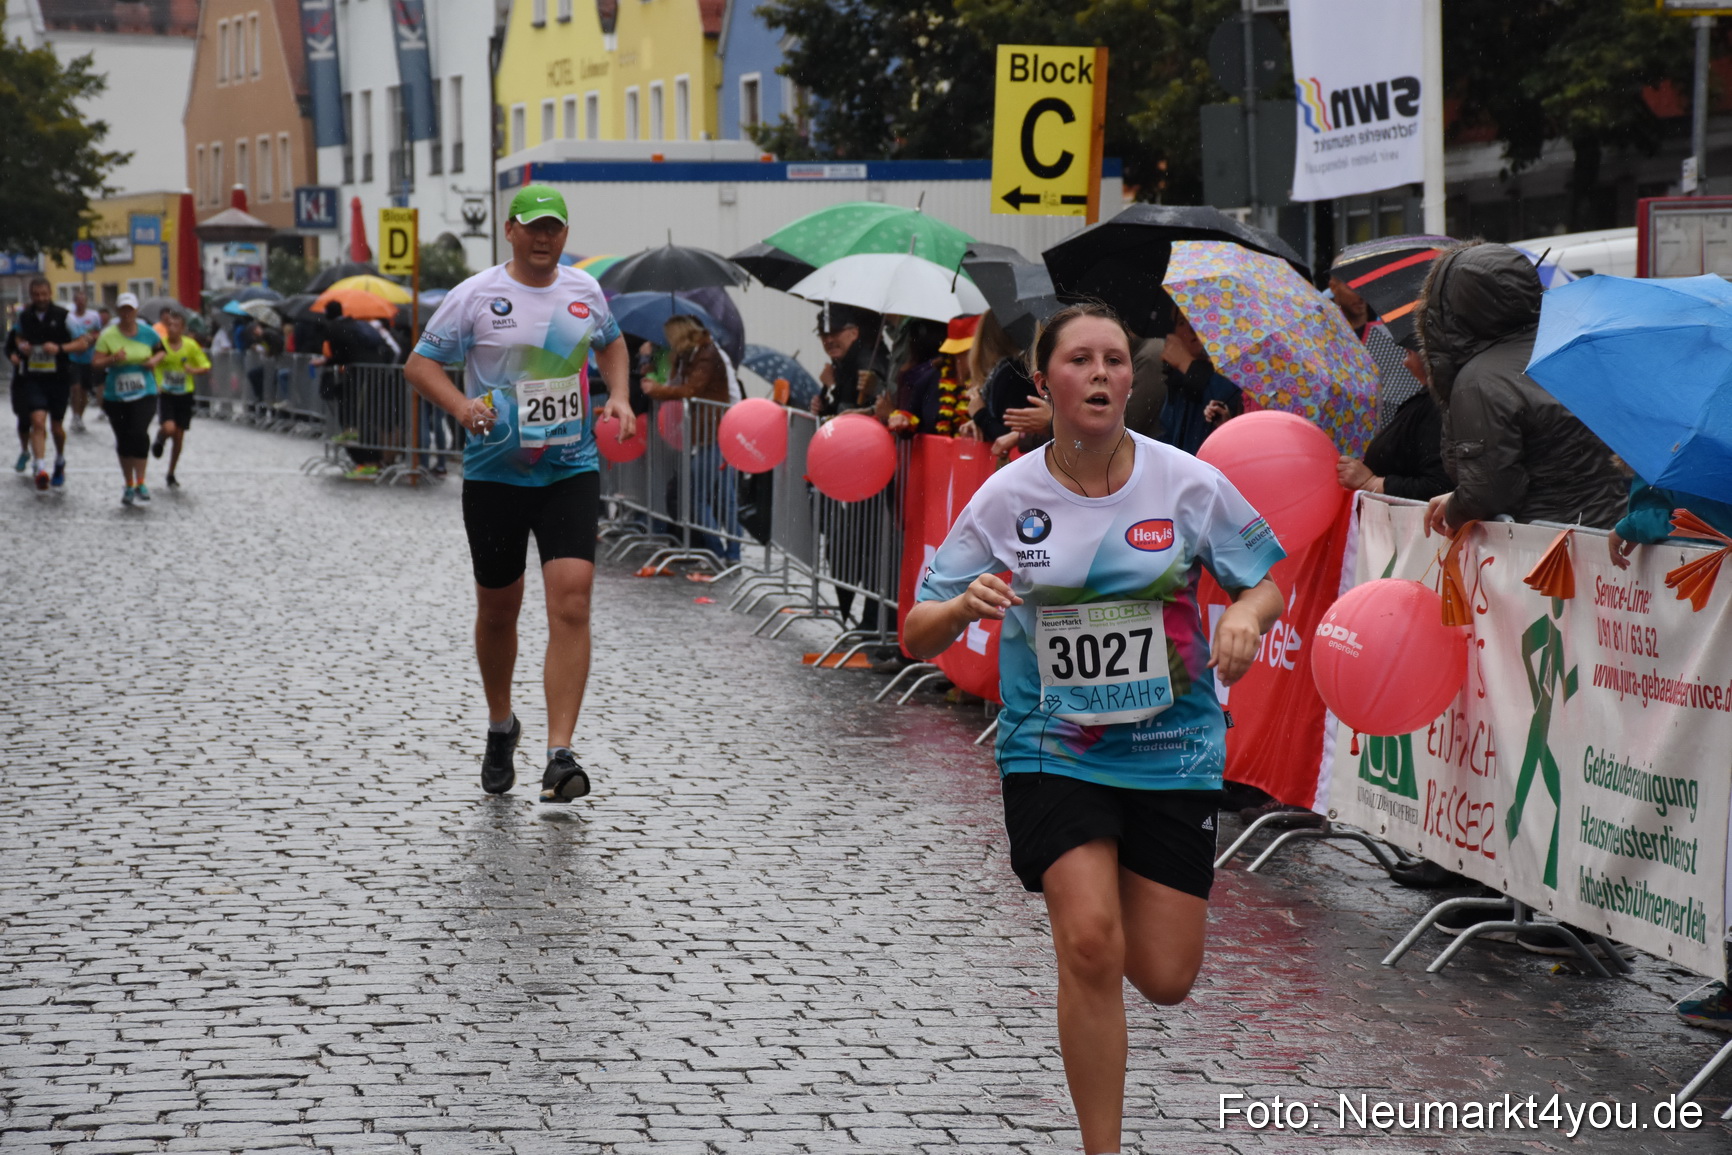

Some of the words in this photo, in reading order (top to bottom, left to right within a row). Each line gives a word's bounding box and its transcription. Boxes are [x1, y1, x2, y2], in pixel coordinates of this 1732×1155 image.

[1010, 53, 1093, 84] Block
[1020, 97, 1076, 179] C
[383, 210, 413, 222] Block
[390, 229, 409, 259] D
[526, 391, 579, 423] 2619
[1133, 527, 1172, 543] Hervis
[1016, 549, 1051, 561] PARTL
[1594, 575, 1652, 615] Service-Line:
[1041, 618, 1083, 627] NeuerMarkt
[1088, 603, 1152, 622] BOCK
[1049, 628, 1153, 680] 3027
[1613, 620, 1623, 652] 81
[1631, 624, 1643, 656] 63
[1645, 627, 1659, 659] 52
[1068, 680, 1151, 711] SARAH
[1131, 740, 1189, 753] Stadtlauf
[1132, 727, 1200, 742] Neumarkter
[1584, 745, 1698, 823] Gebäudereinigung
[1580, 804, 1698, 876] Hausmeisterdienst
[1580, 864, 1707, 945] Arbeitsbühnenverleih
